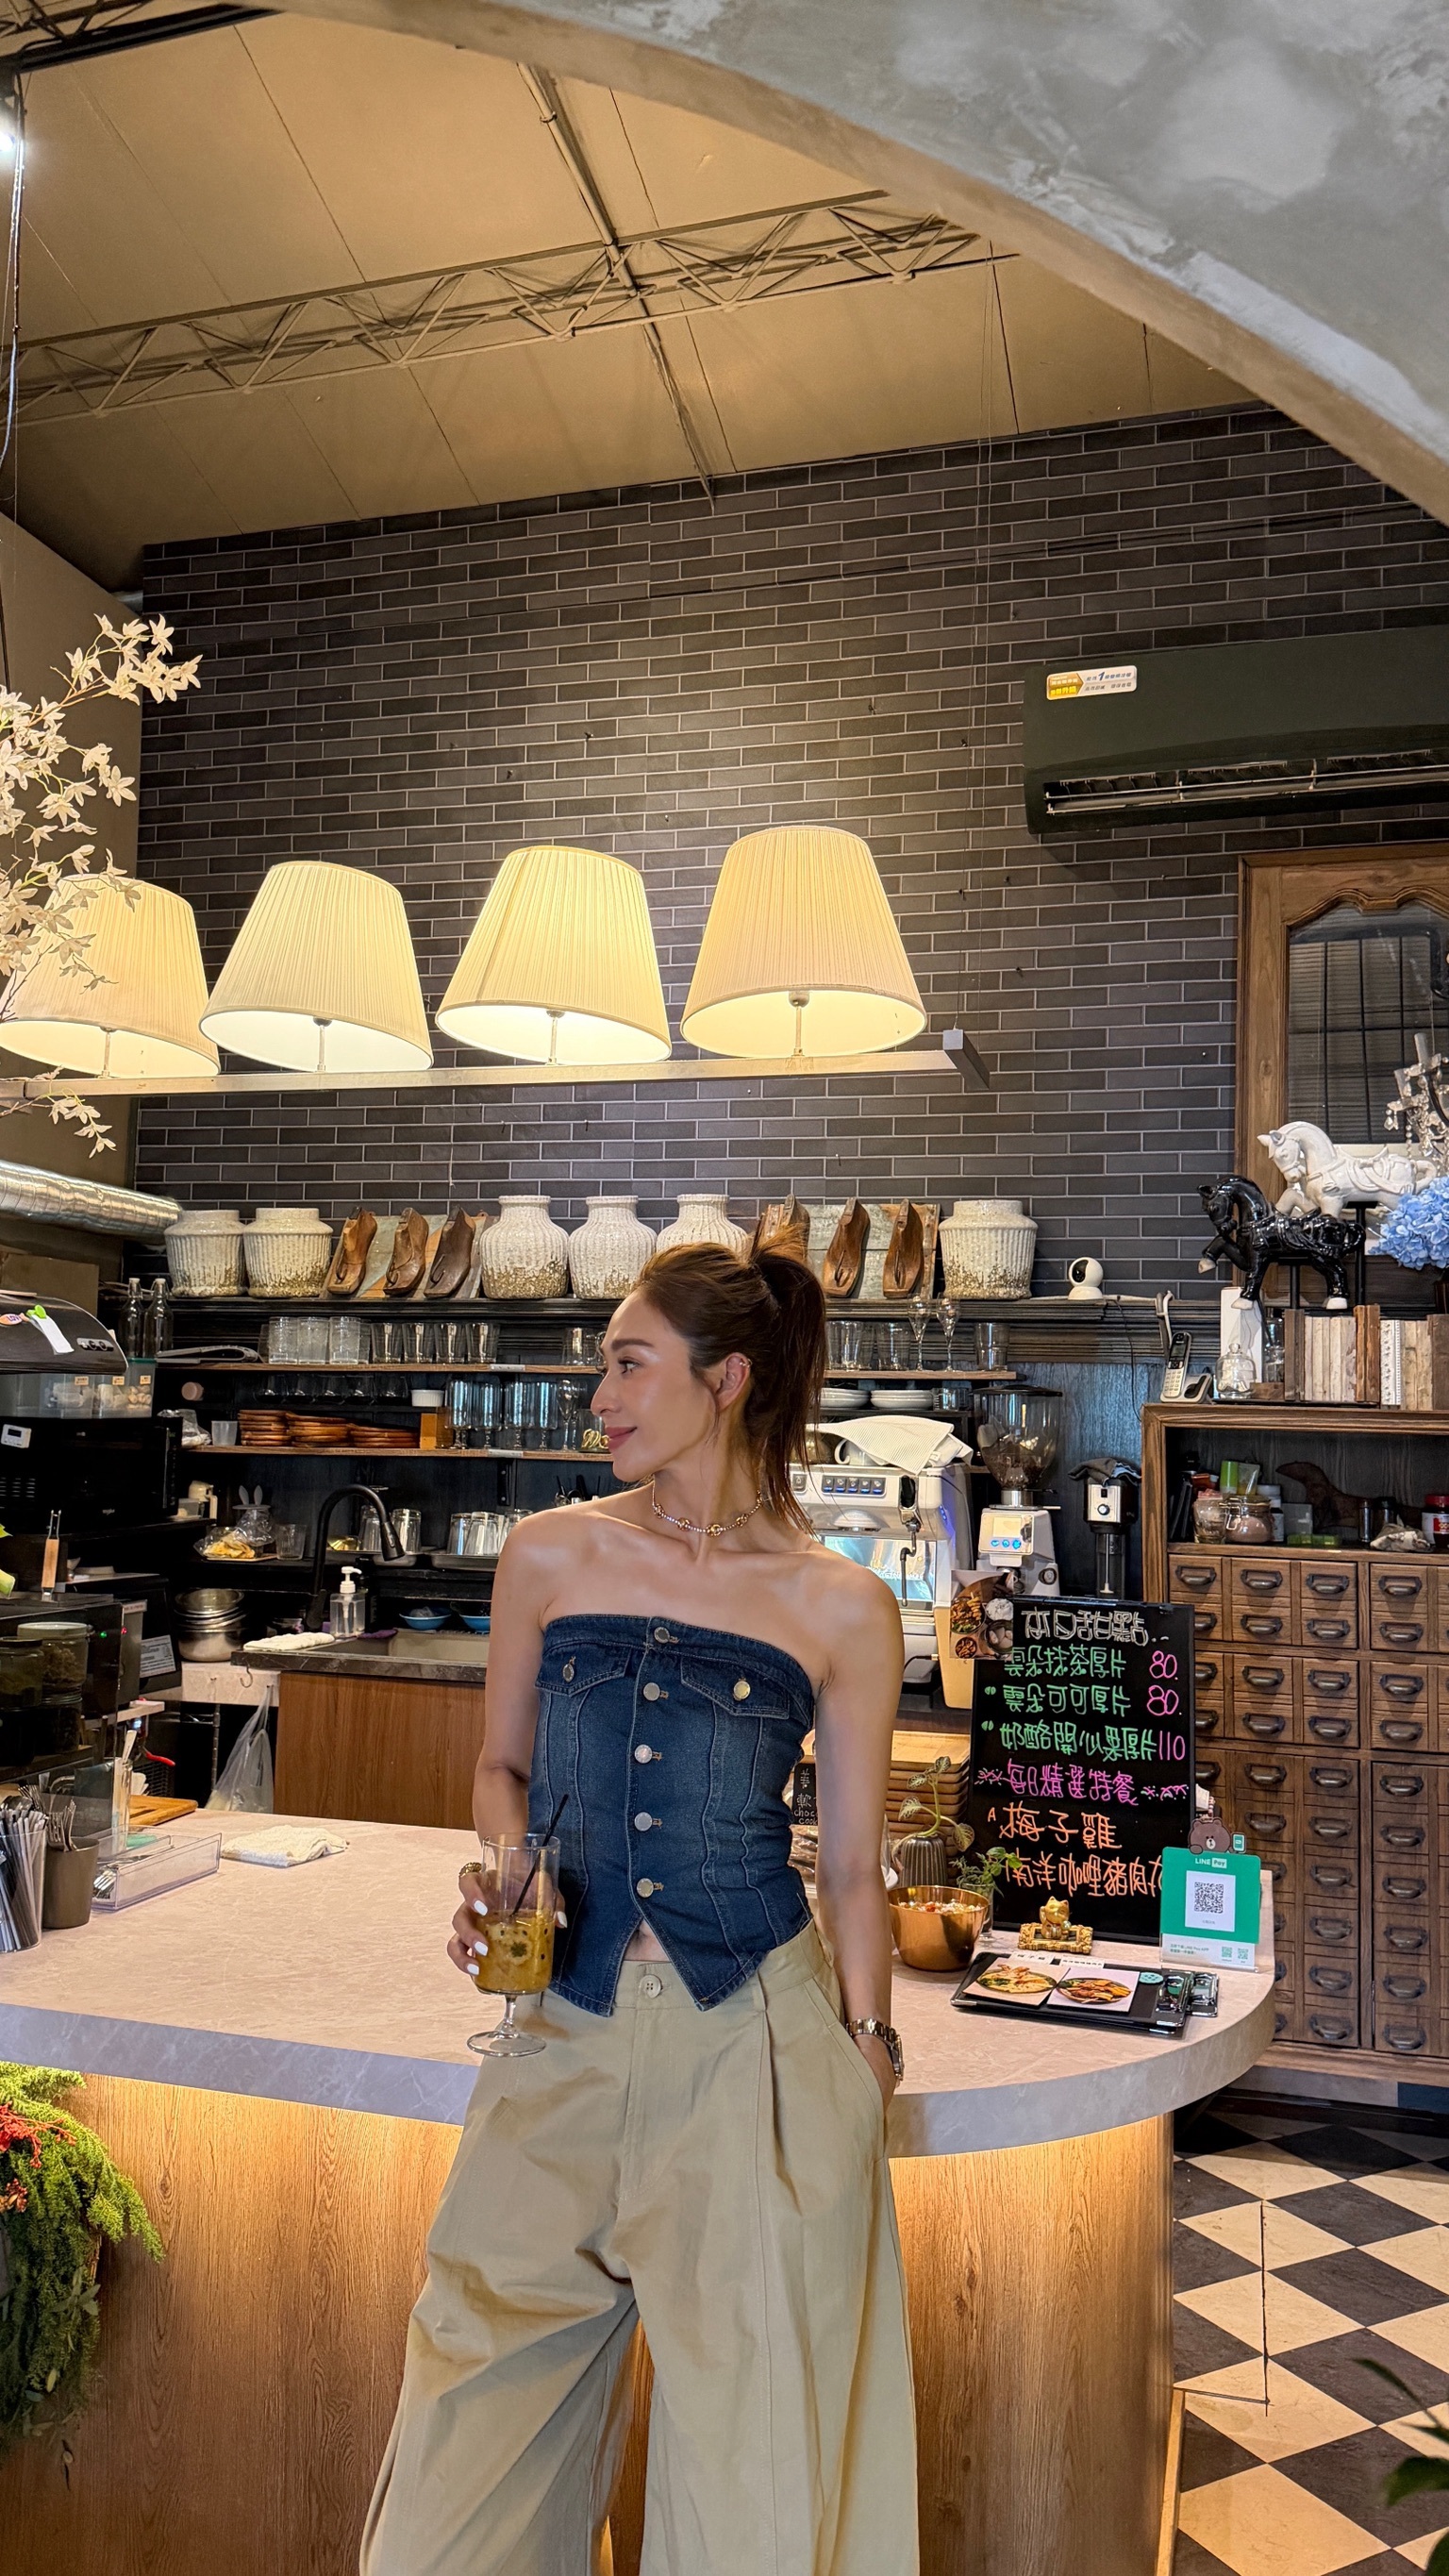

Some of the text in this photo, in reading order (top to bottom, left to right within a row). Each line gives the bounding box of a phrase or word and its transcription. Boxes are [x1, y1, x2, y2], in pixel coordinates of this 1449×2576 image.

[1003, 1683, 1131, 1717] 雲朵可可厚片
[1000, 1719, 1186, 1762] 奶酪開心果厚片 110
[999, 1800, 1123, 1849] 梅子雞
[1194, 1857, 1226, 1867] LINE Pay
